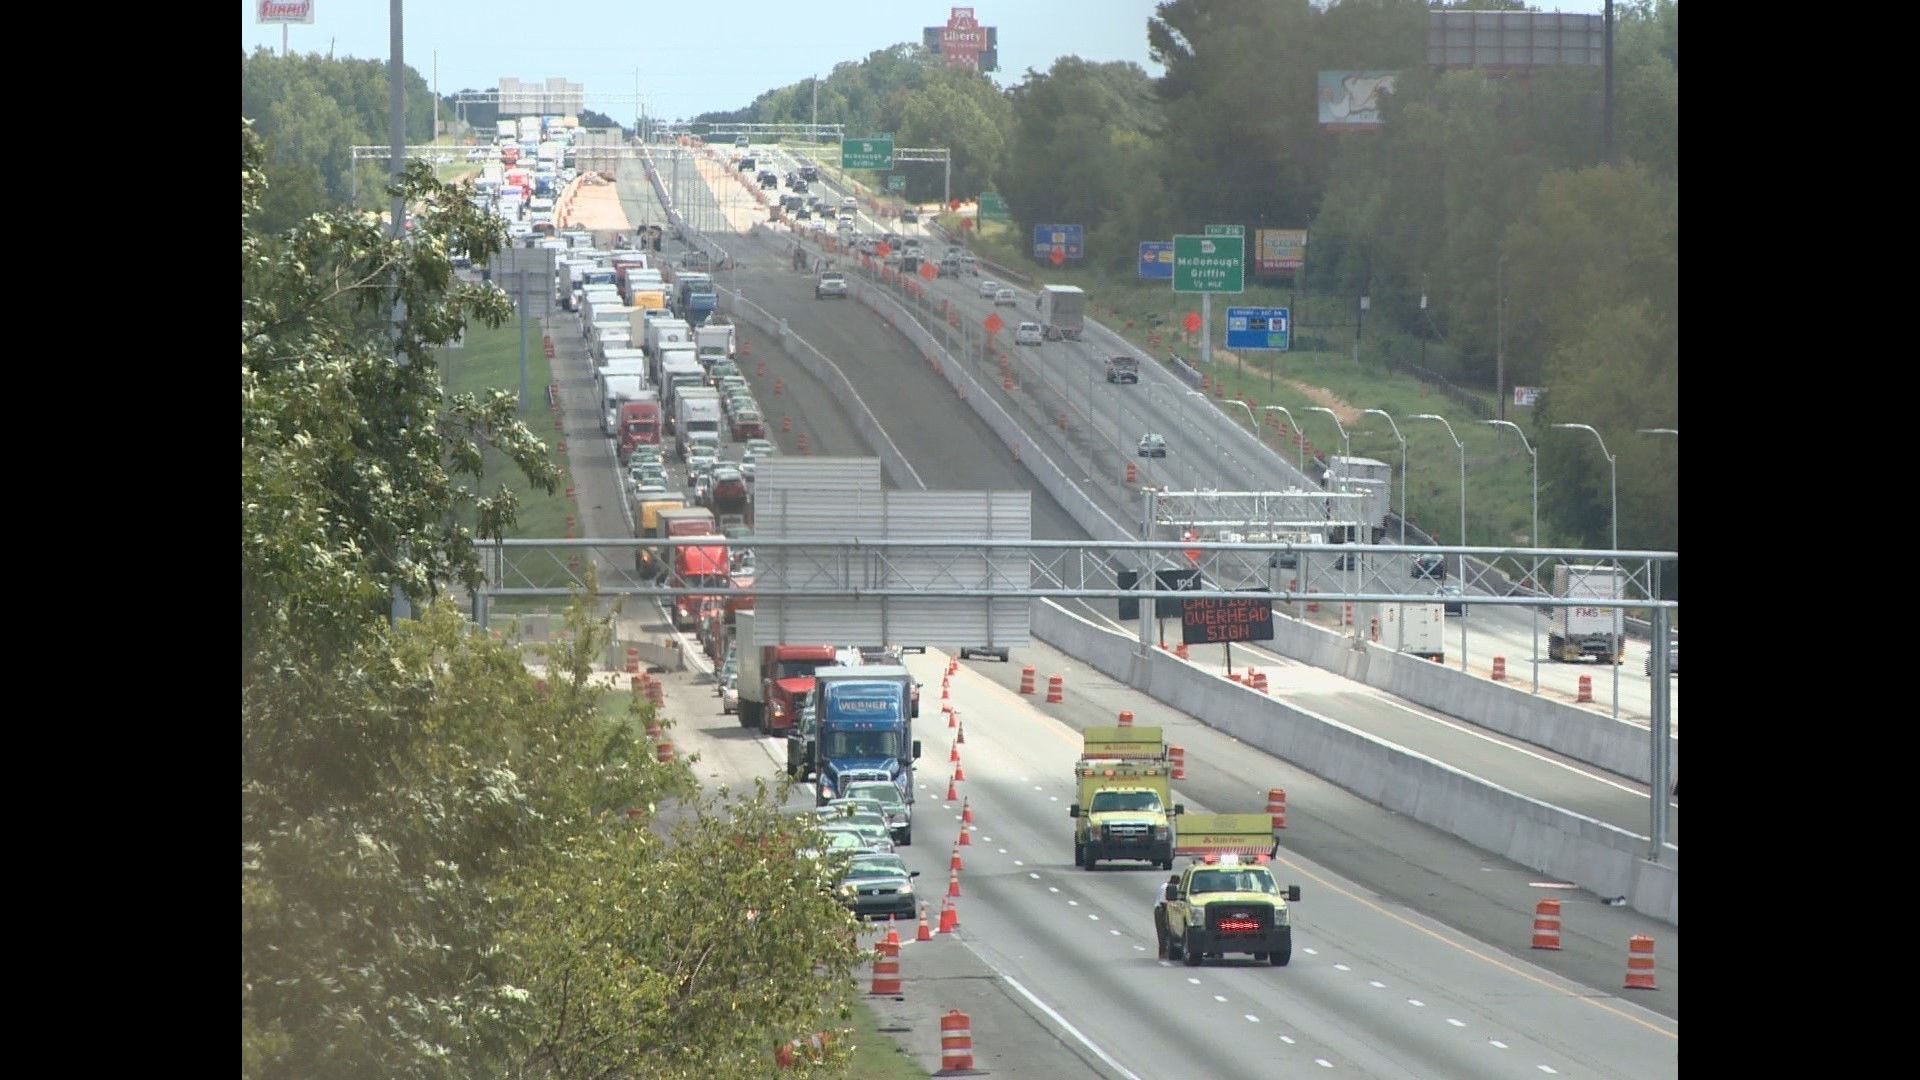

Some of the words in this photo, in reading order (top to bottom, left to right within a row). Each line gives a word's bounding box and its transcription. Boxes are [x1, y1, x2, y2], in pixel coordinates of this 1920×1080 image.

[943, 31, 980, 41] Liberty
[1177, 257, 1239, 268] McDonough
[1190, 269, 1226, 278] Griffin
[1184, 607, 1269, 626] OVERHEAD
[1207, 624, 1250, 640] SIGN
[841, 701, 887, 710] WERNER
